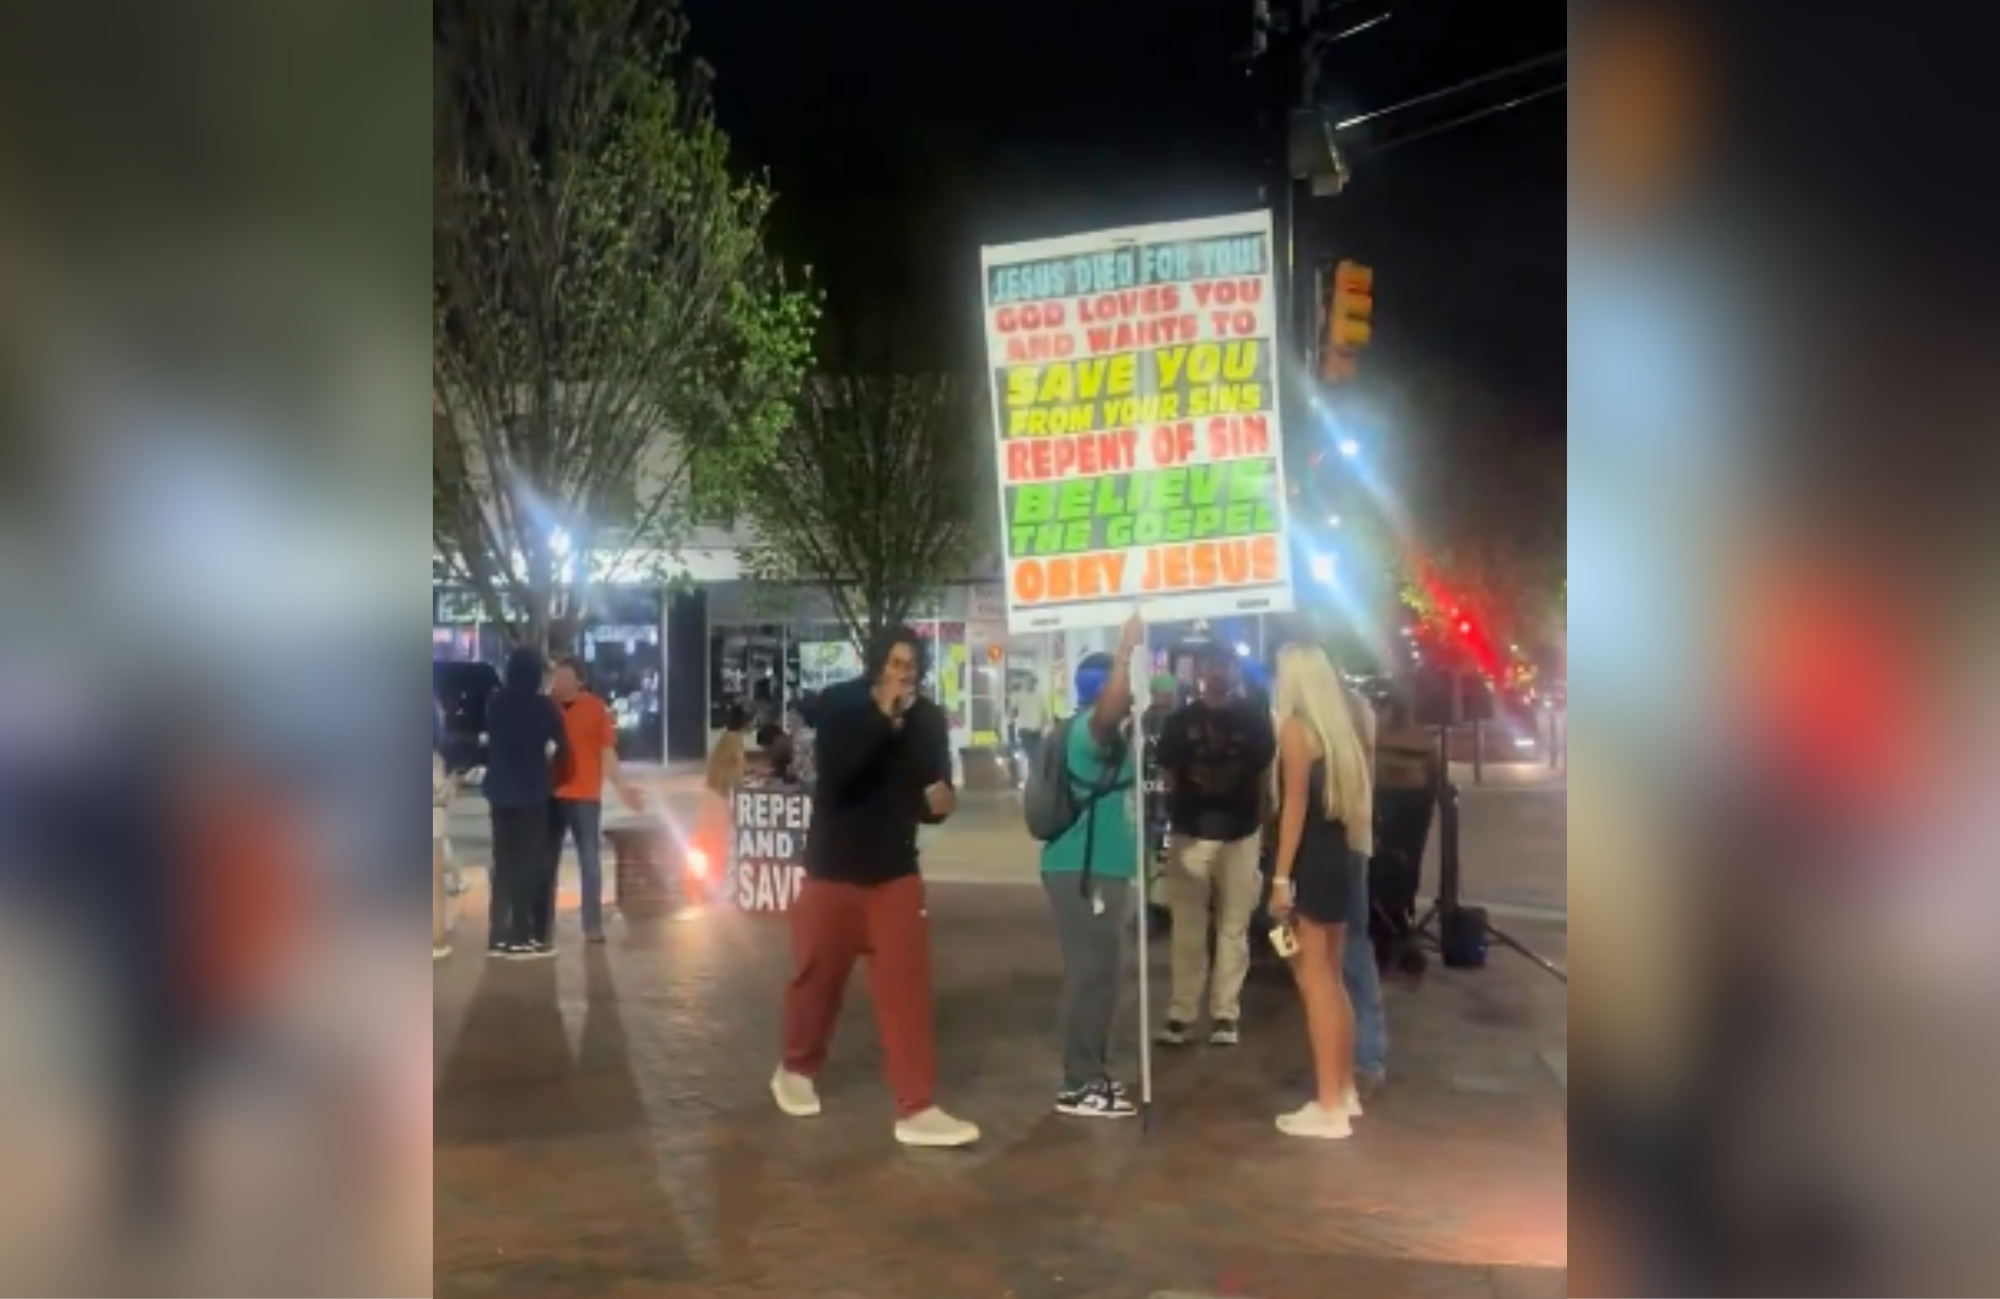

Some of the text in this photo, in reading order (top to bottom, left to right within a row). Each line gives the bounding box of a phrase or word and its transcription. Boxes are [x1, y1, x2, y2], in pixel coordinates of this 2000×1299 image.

[994, 236, 1261, 302] JESUS DIED FOR YOU!
[996, 279, 1261, 332] GOD LOVES YOU
[1006, 310, 1256, 361] AND WANTS TO
[1008, 342, 1258, 405] SAVE YOU
[1010, 383, 1260, 436] FROM YOUR SINS
[1007, 415, 1267, 481] REPENT OF SIN
[1014, 459, 1267, 524] BELIEVE
[1012, 503, 1275, 555] THE GOSPEL
[1013, 552, 1125, 602] OBEY
[1140, 535, 1276, 591] JESUS
[739, 830, 793, 858] AND
